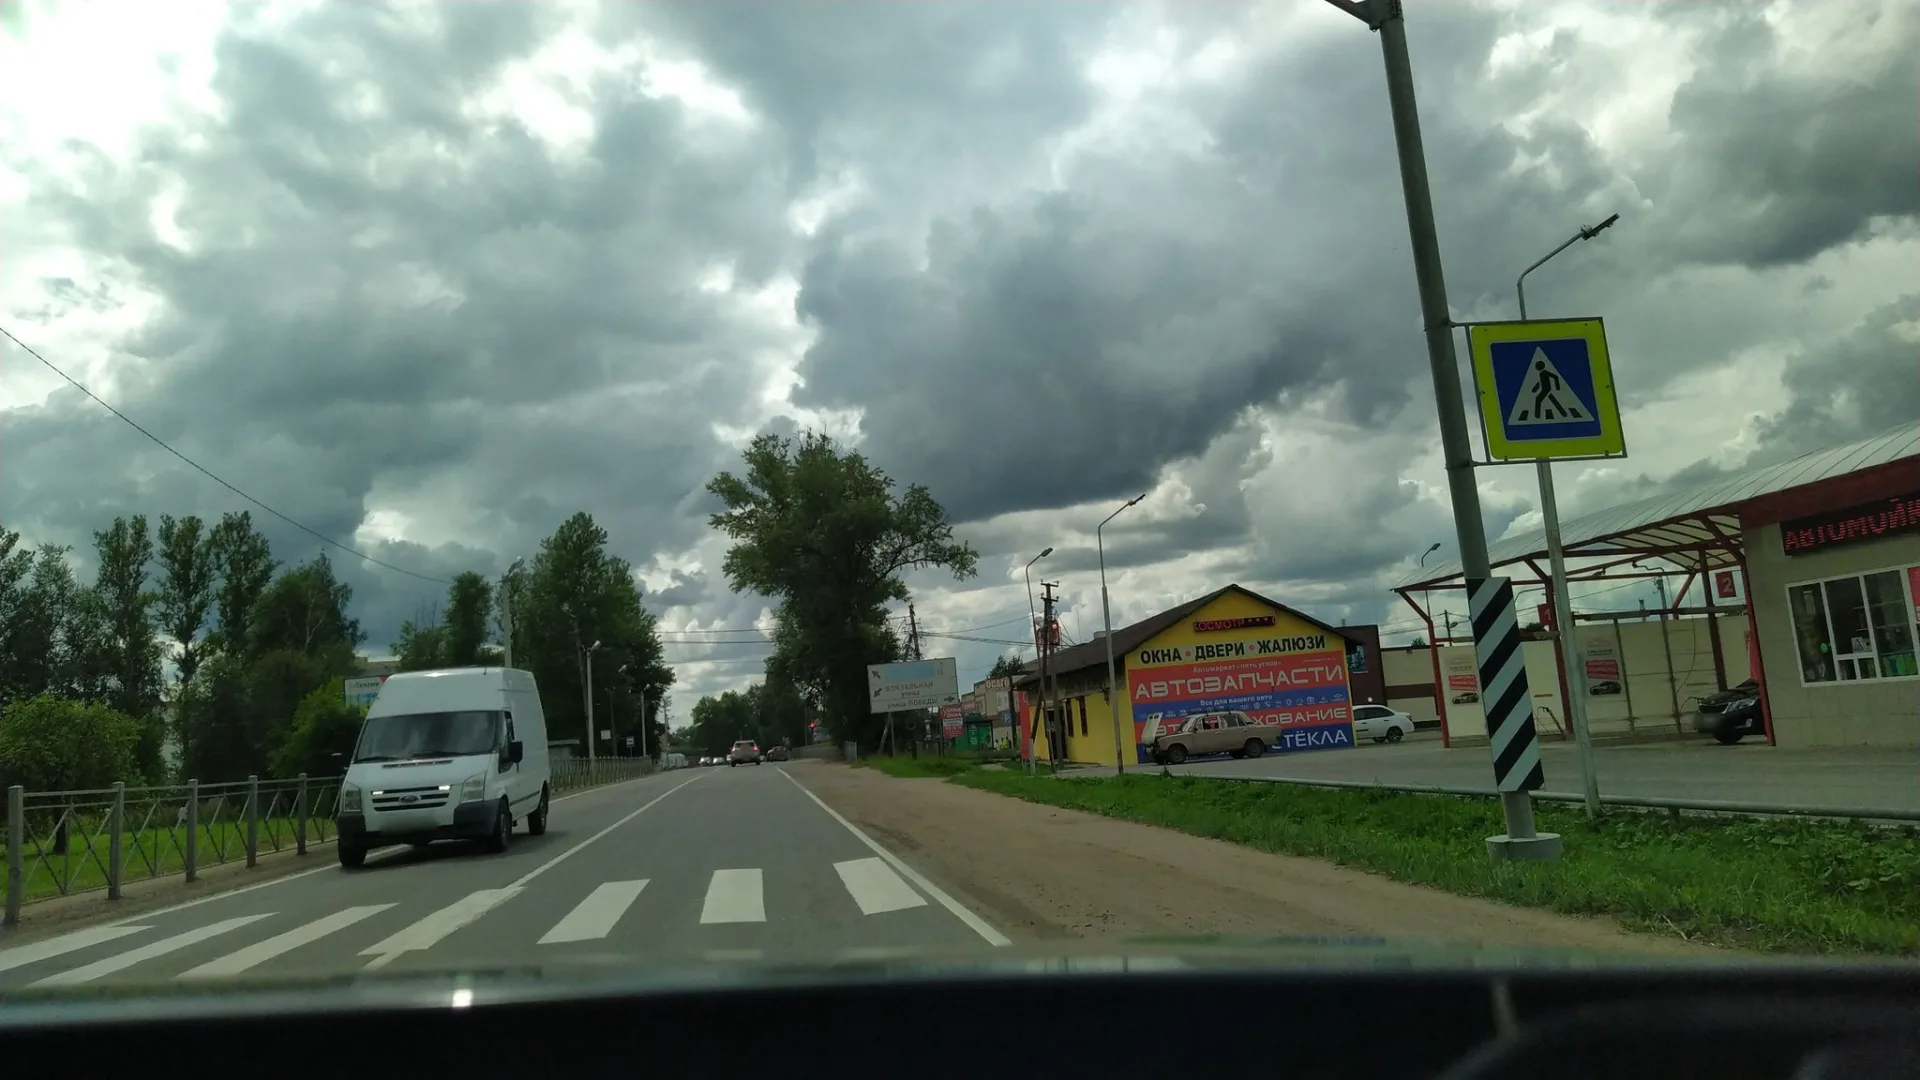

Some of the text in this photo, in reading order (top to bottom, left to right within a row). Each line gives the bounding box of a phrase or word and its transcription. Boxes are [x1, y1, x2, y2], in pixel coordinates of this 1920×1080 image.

[1722, 577, 1734, 593] 2
[1141, 635, 1326, 664] ОКНА ДВЕРИ ЖАЛЮЗИ
[1135, 665, 1344, 700] АВТОЗАПЧАСТИ
[908, 698, 937, 706] ПОБЕДЫ
